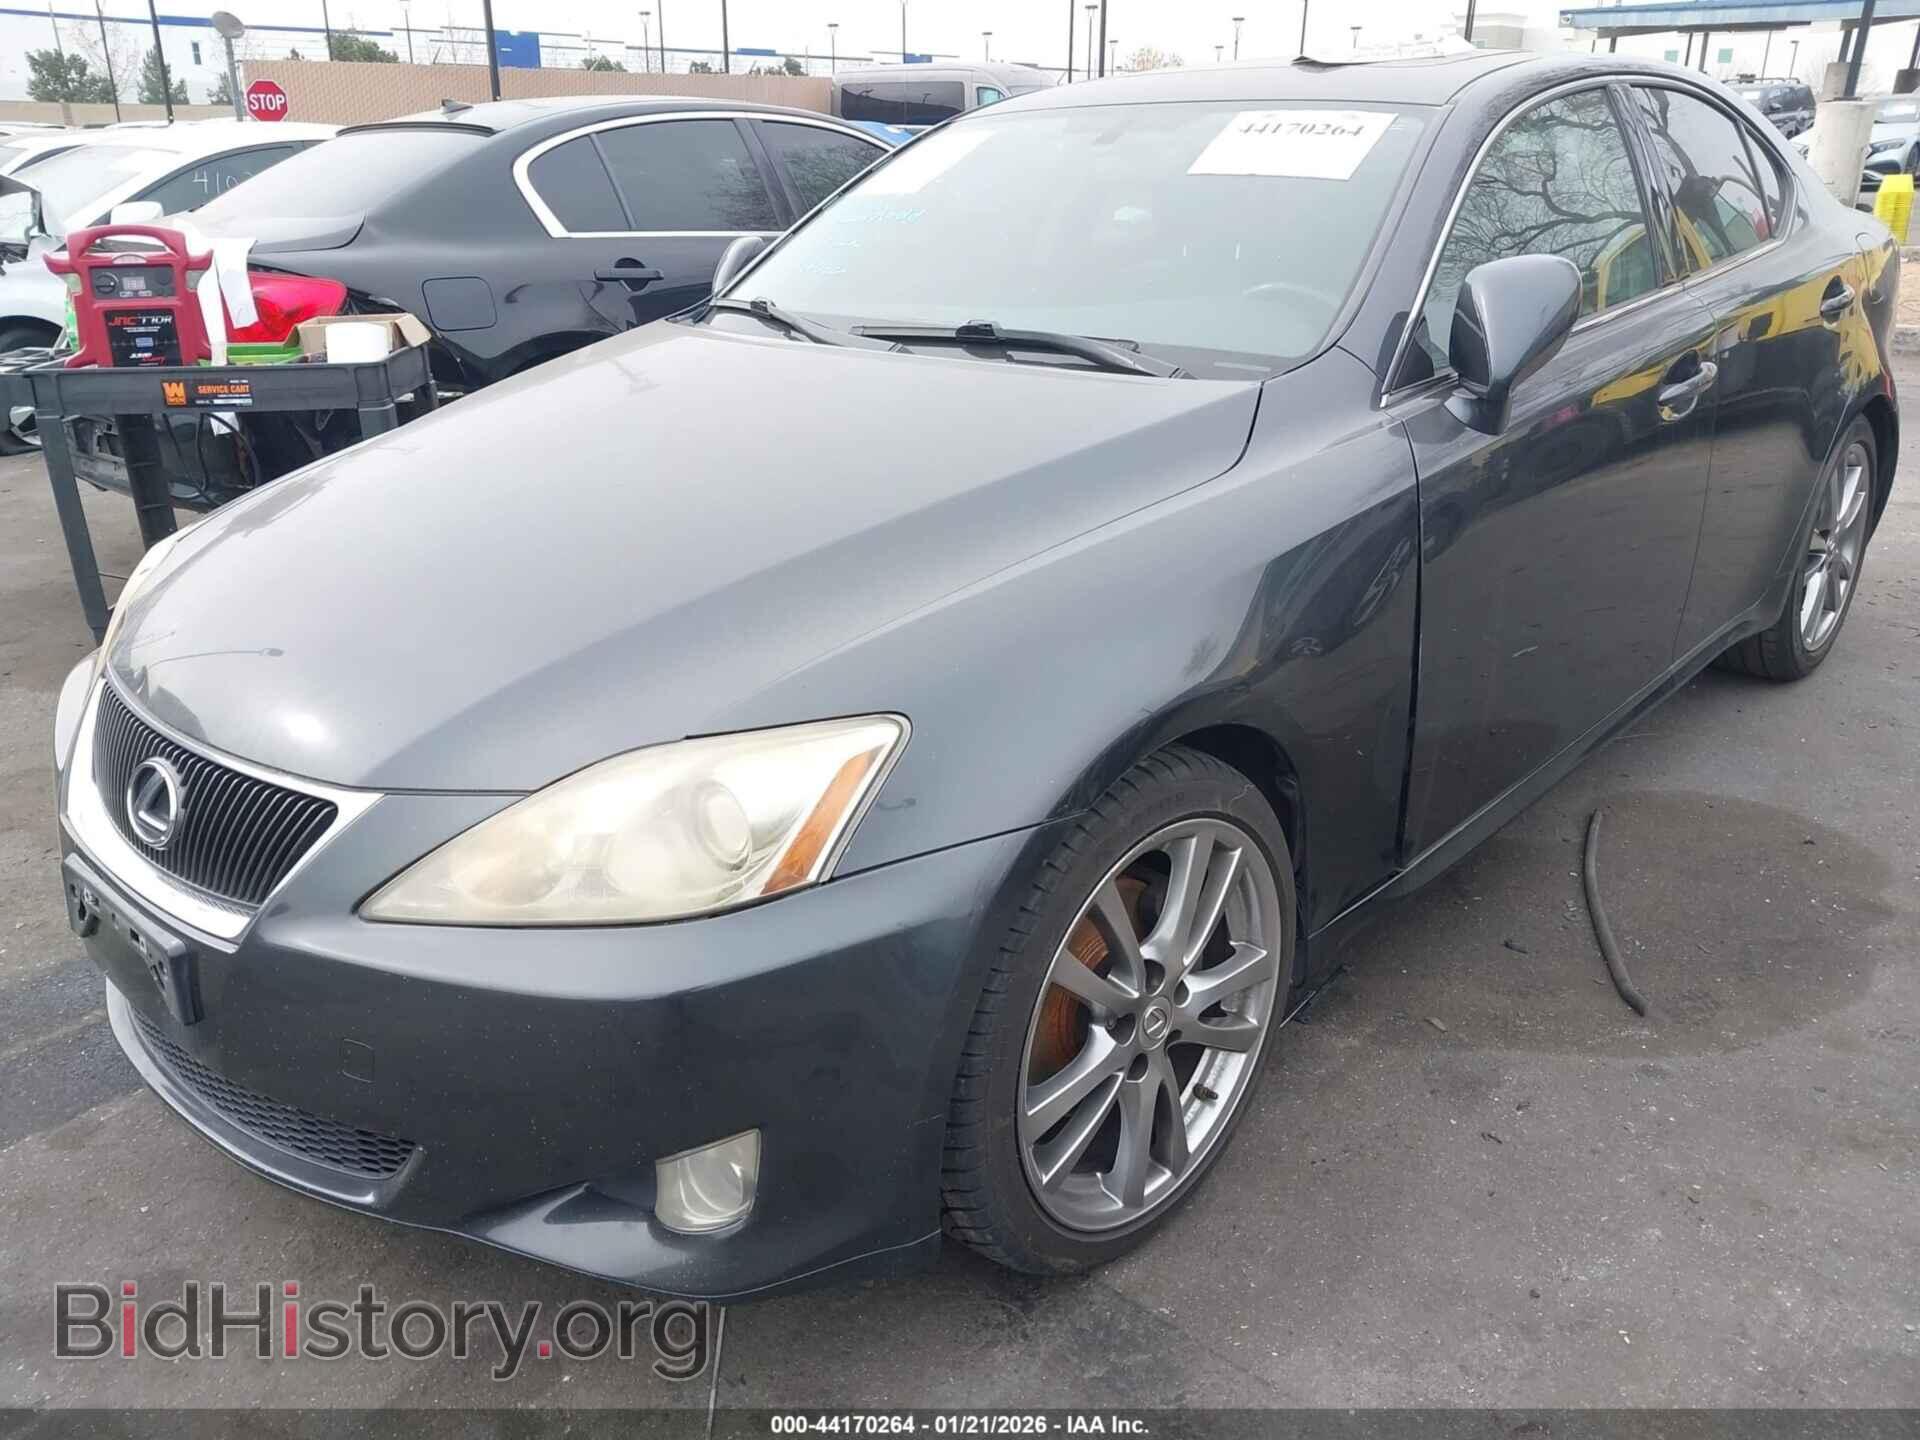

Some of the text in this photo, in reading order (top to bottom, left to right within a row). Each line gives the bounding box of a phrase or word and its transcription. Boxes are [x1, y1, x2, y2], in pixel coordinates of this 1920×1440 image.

[249, 93, 285, 111] STOP
[1239, 122, 1366, 137] 44170264
[198, 384, 250, 394] SERVICE CART
